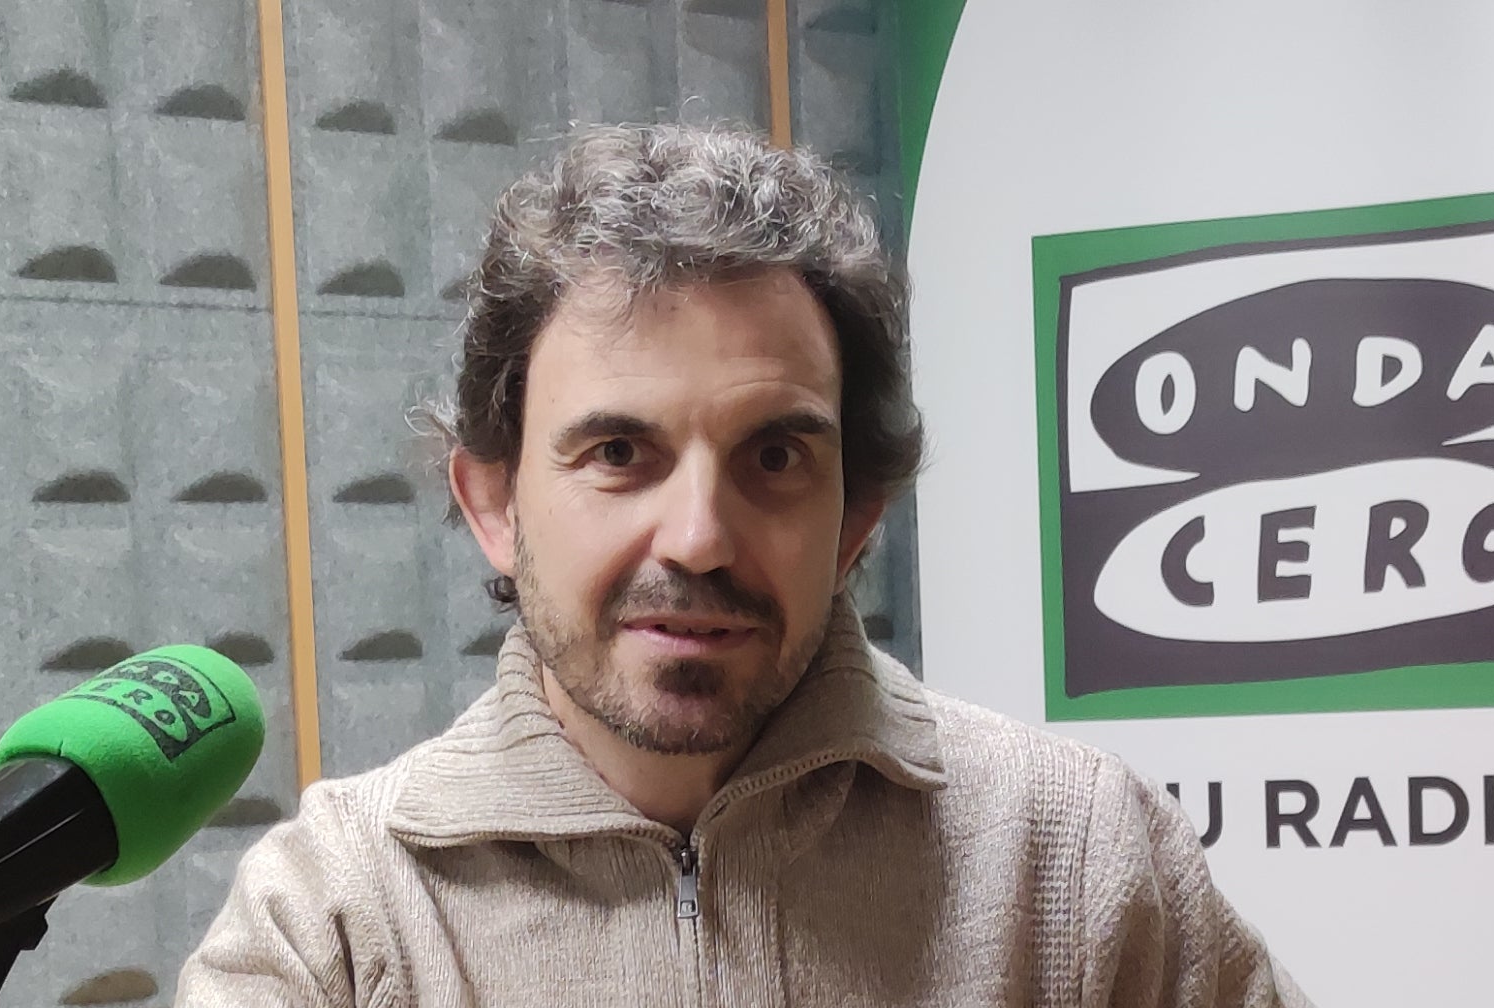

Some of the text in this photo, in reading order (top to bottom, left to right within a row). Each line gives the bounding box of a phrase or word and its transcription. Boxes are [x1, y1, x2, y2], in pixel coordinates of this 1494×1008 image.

[89, 680, 177, 726] ERO
[116, 663, 200, 708] NDA
[1165, 780, 1224, 849] U
